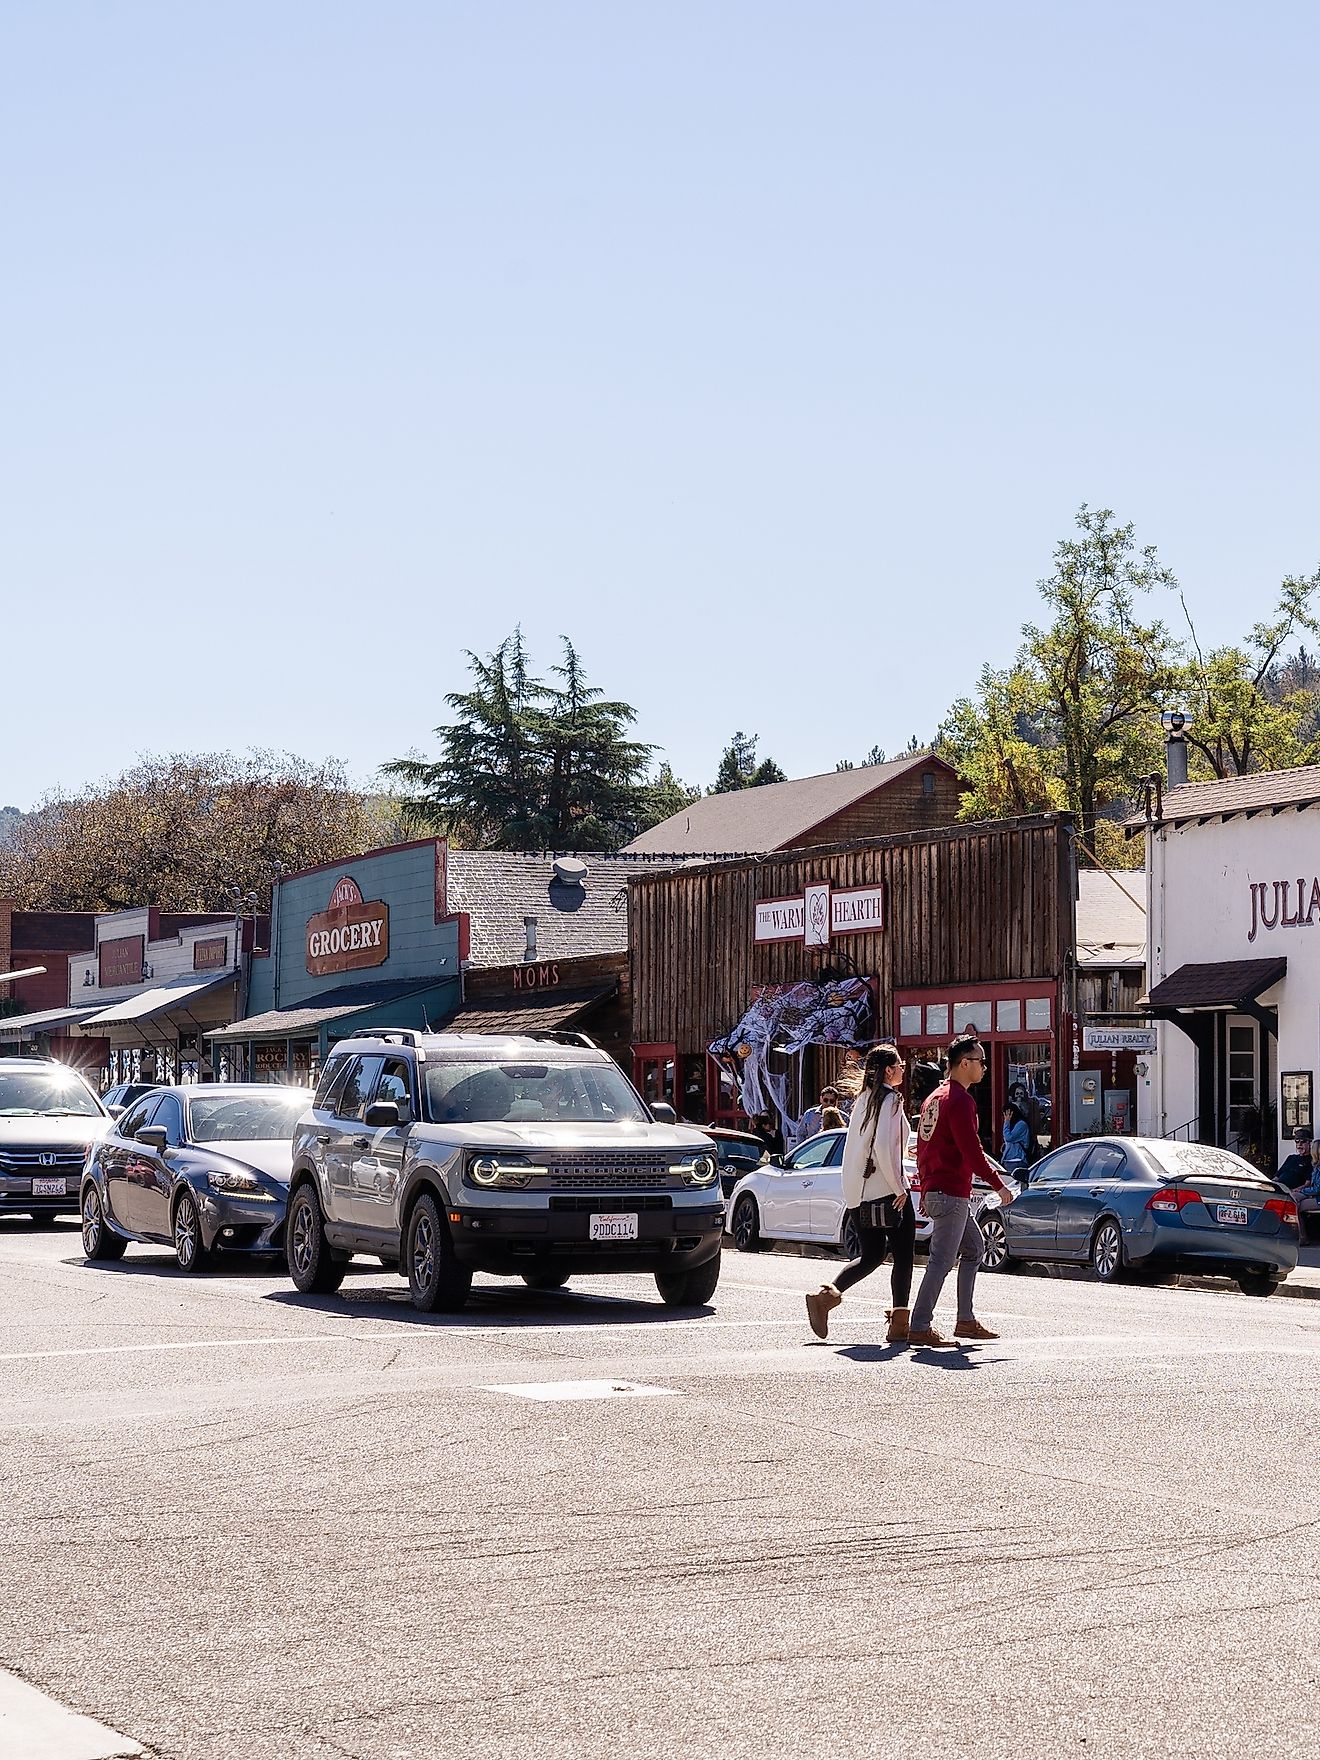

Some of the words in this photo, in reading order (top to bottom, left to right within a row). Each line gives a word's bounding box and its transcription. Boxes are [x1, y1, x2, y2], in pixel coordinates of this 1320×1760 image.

[336, 884, 355, 907] JACK'S
[758, 911, 771, 923] THE
[771, 907, 805, 931] WARM
[833, 897, 881, 923] HEARTH
[309, 919, 384, 958] GROCERY
[513, 964, 559, 989] MOMS
[1090, 1034, 1120, 1046] JULIAN
[1121, 1034, 1151, 1044] REALTY
[592, 1223, 635, 1237] 9DDC114
